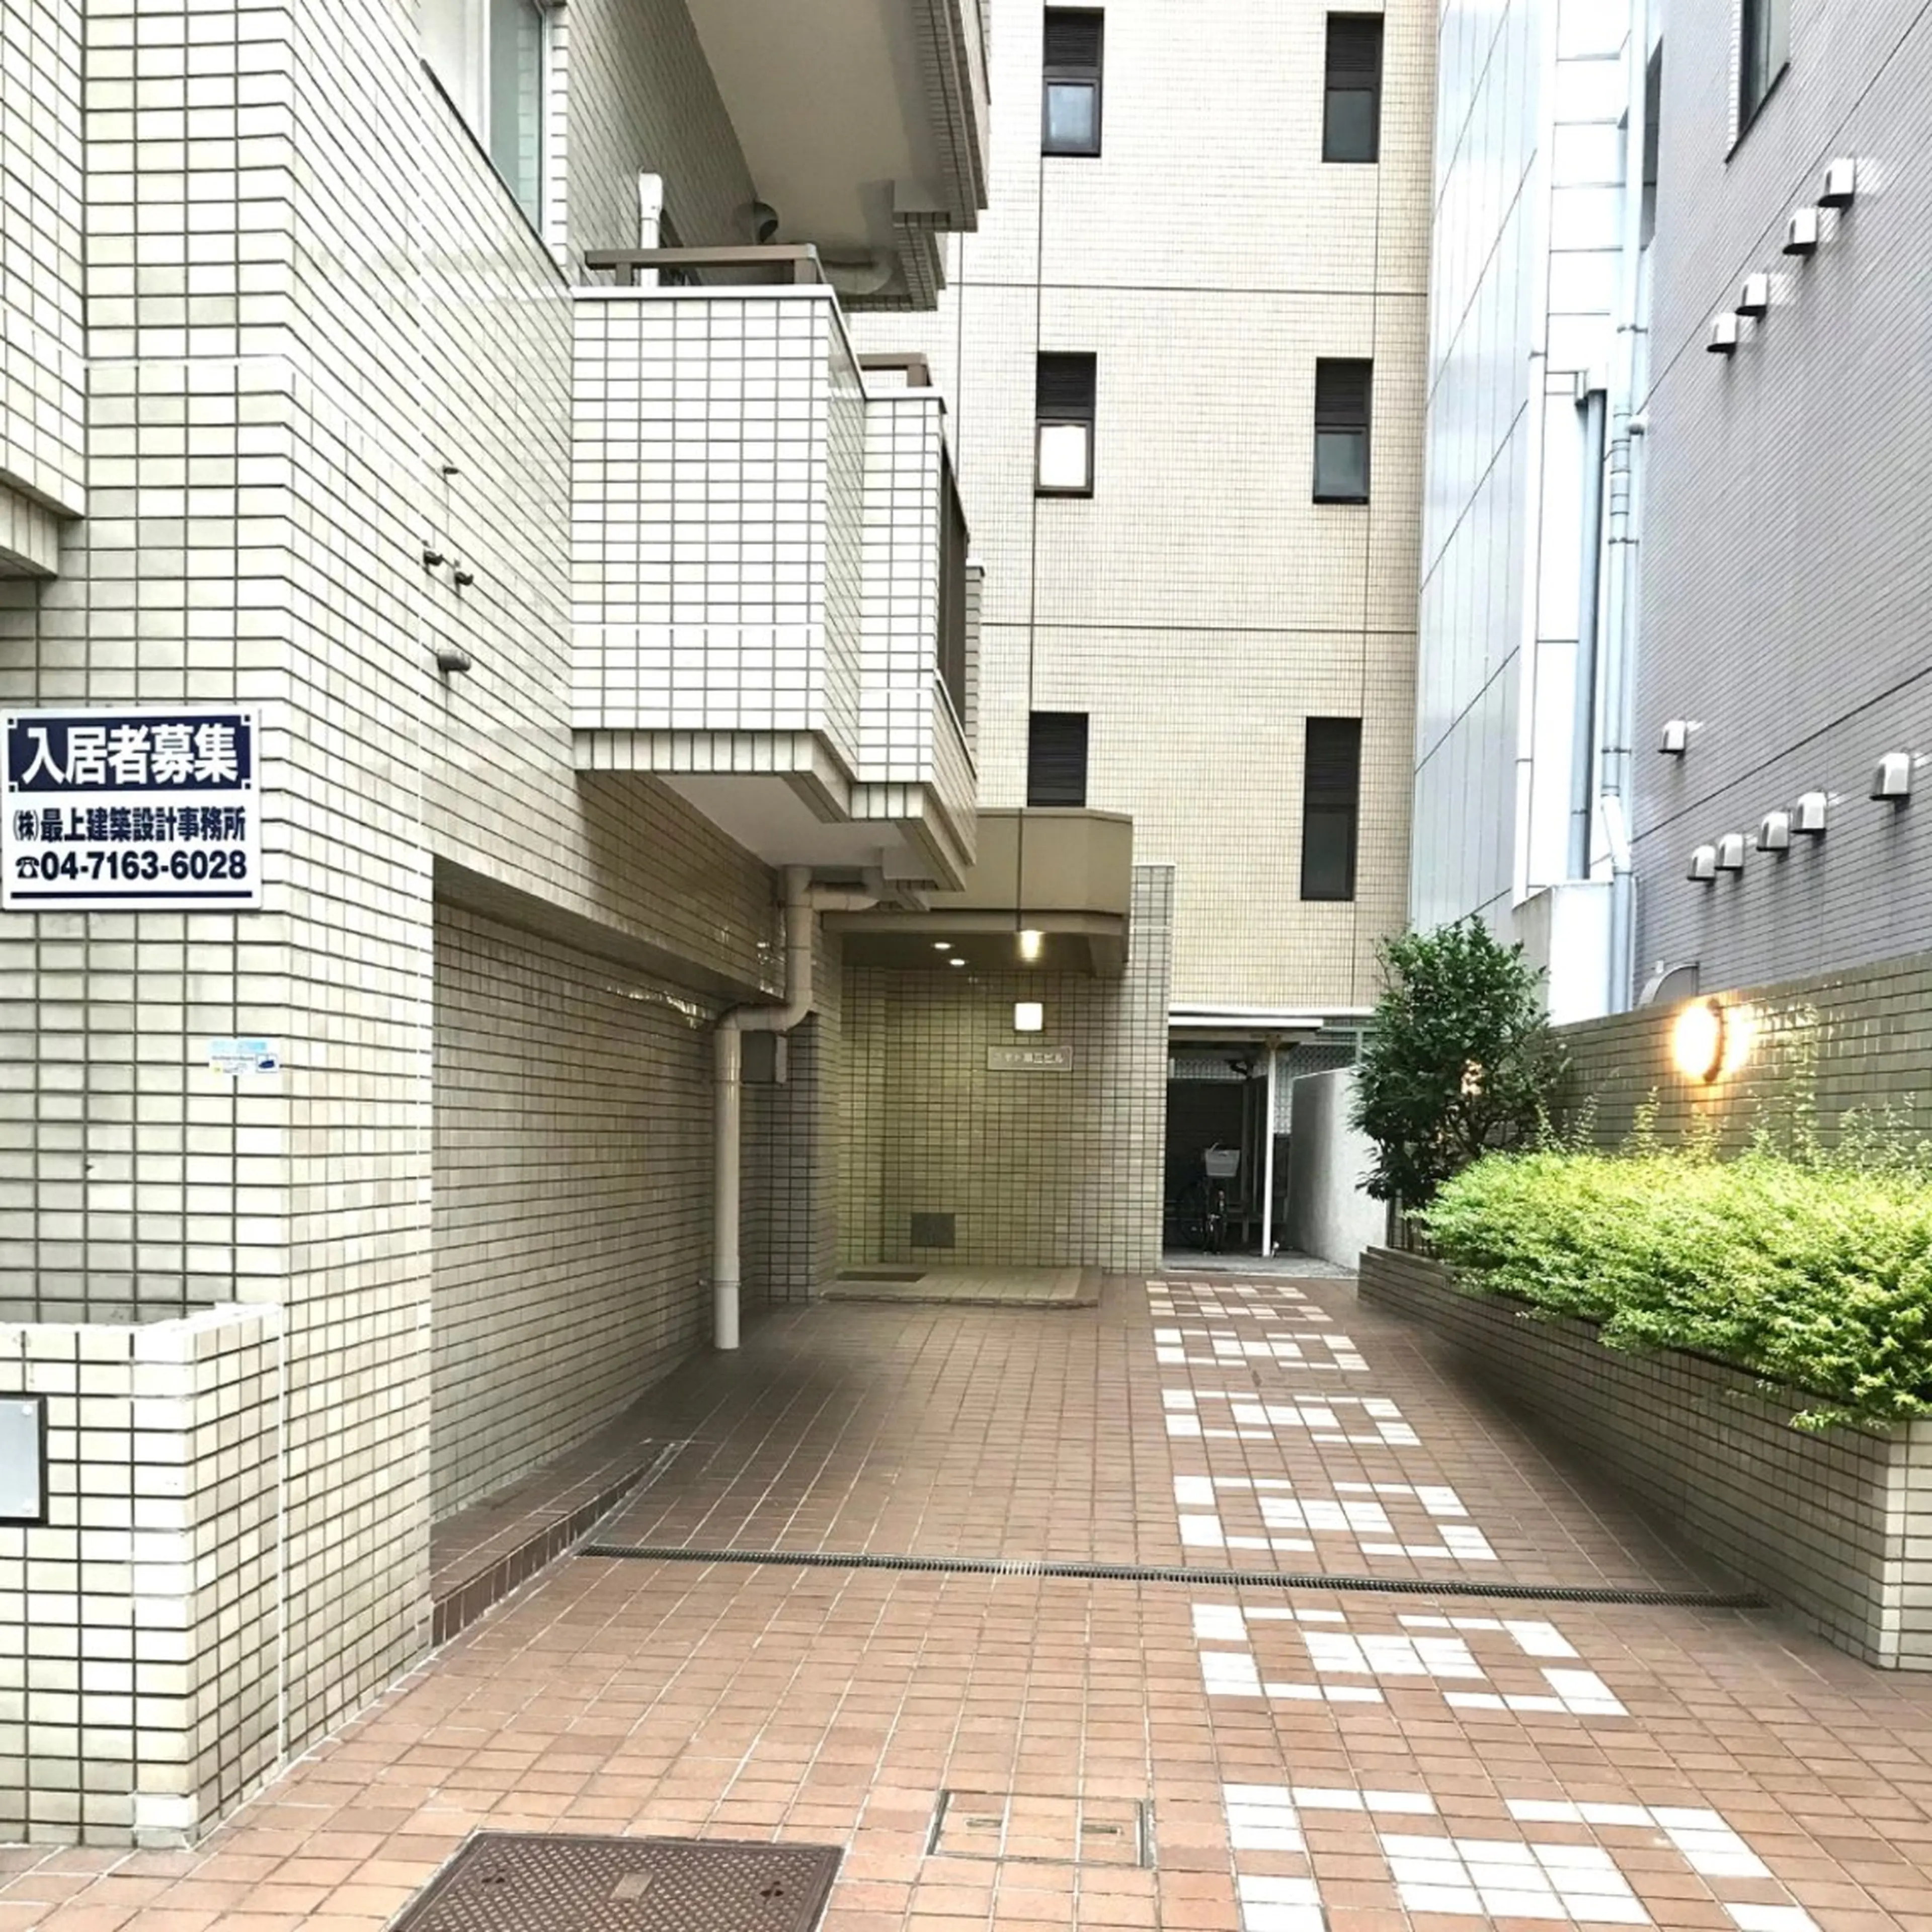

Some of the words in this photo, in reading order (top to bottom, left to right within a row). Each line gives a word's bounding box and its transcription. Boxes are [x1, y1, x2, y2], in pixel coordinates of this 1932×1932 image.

[22, 723, 238, 784] 入居者募集
[41, 850, 247, 880] 04-7163-6028
